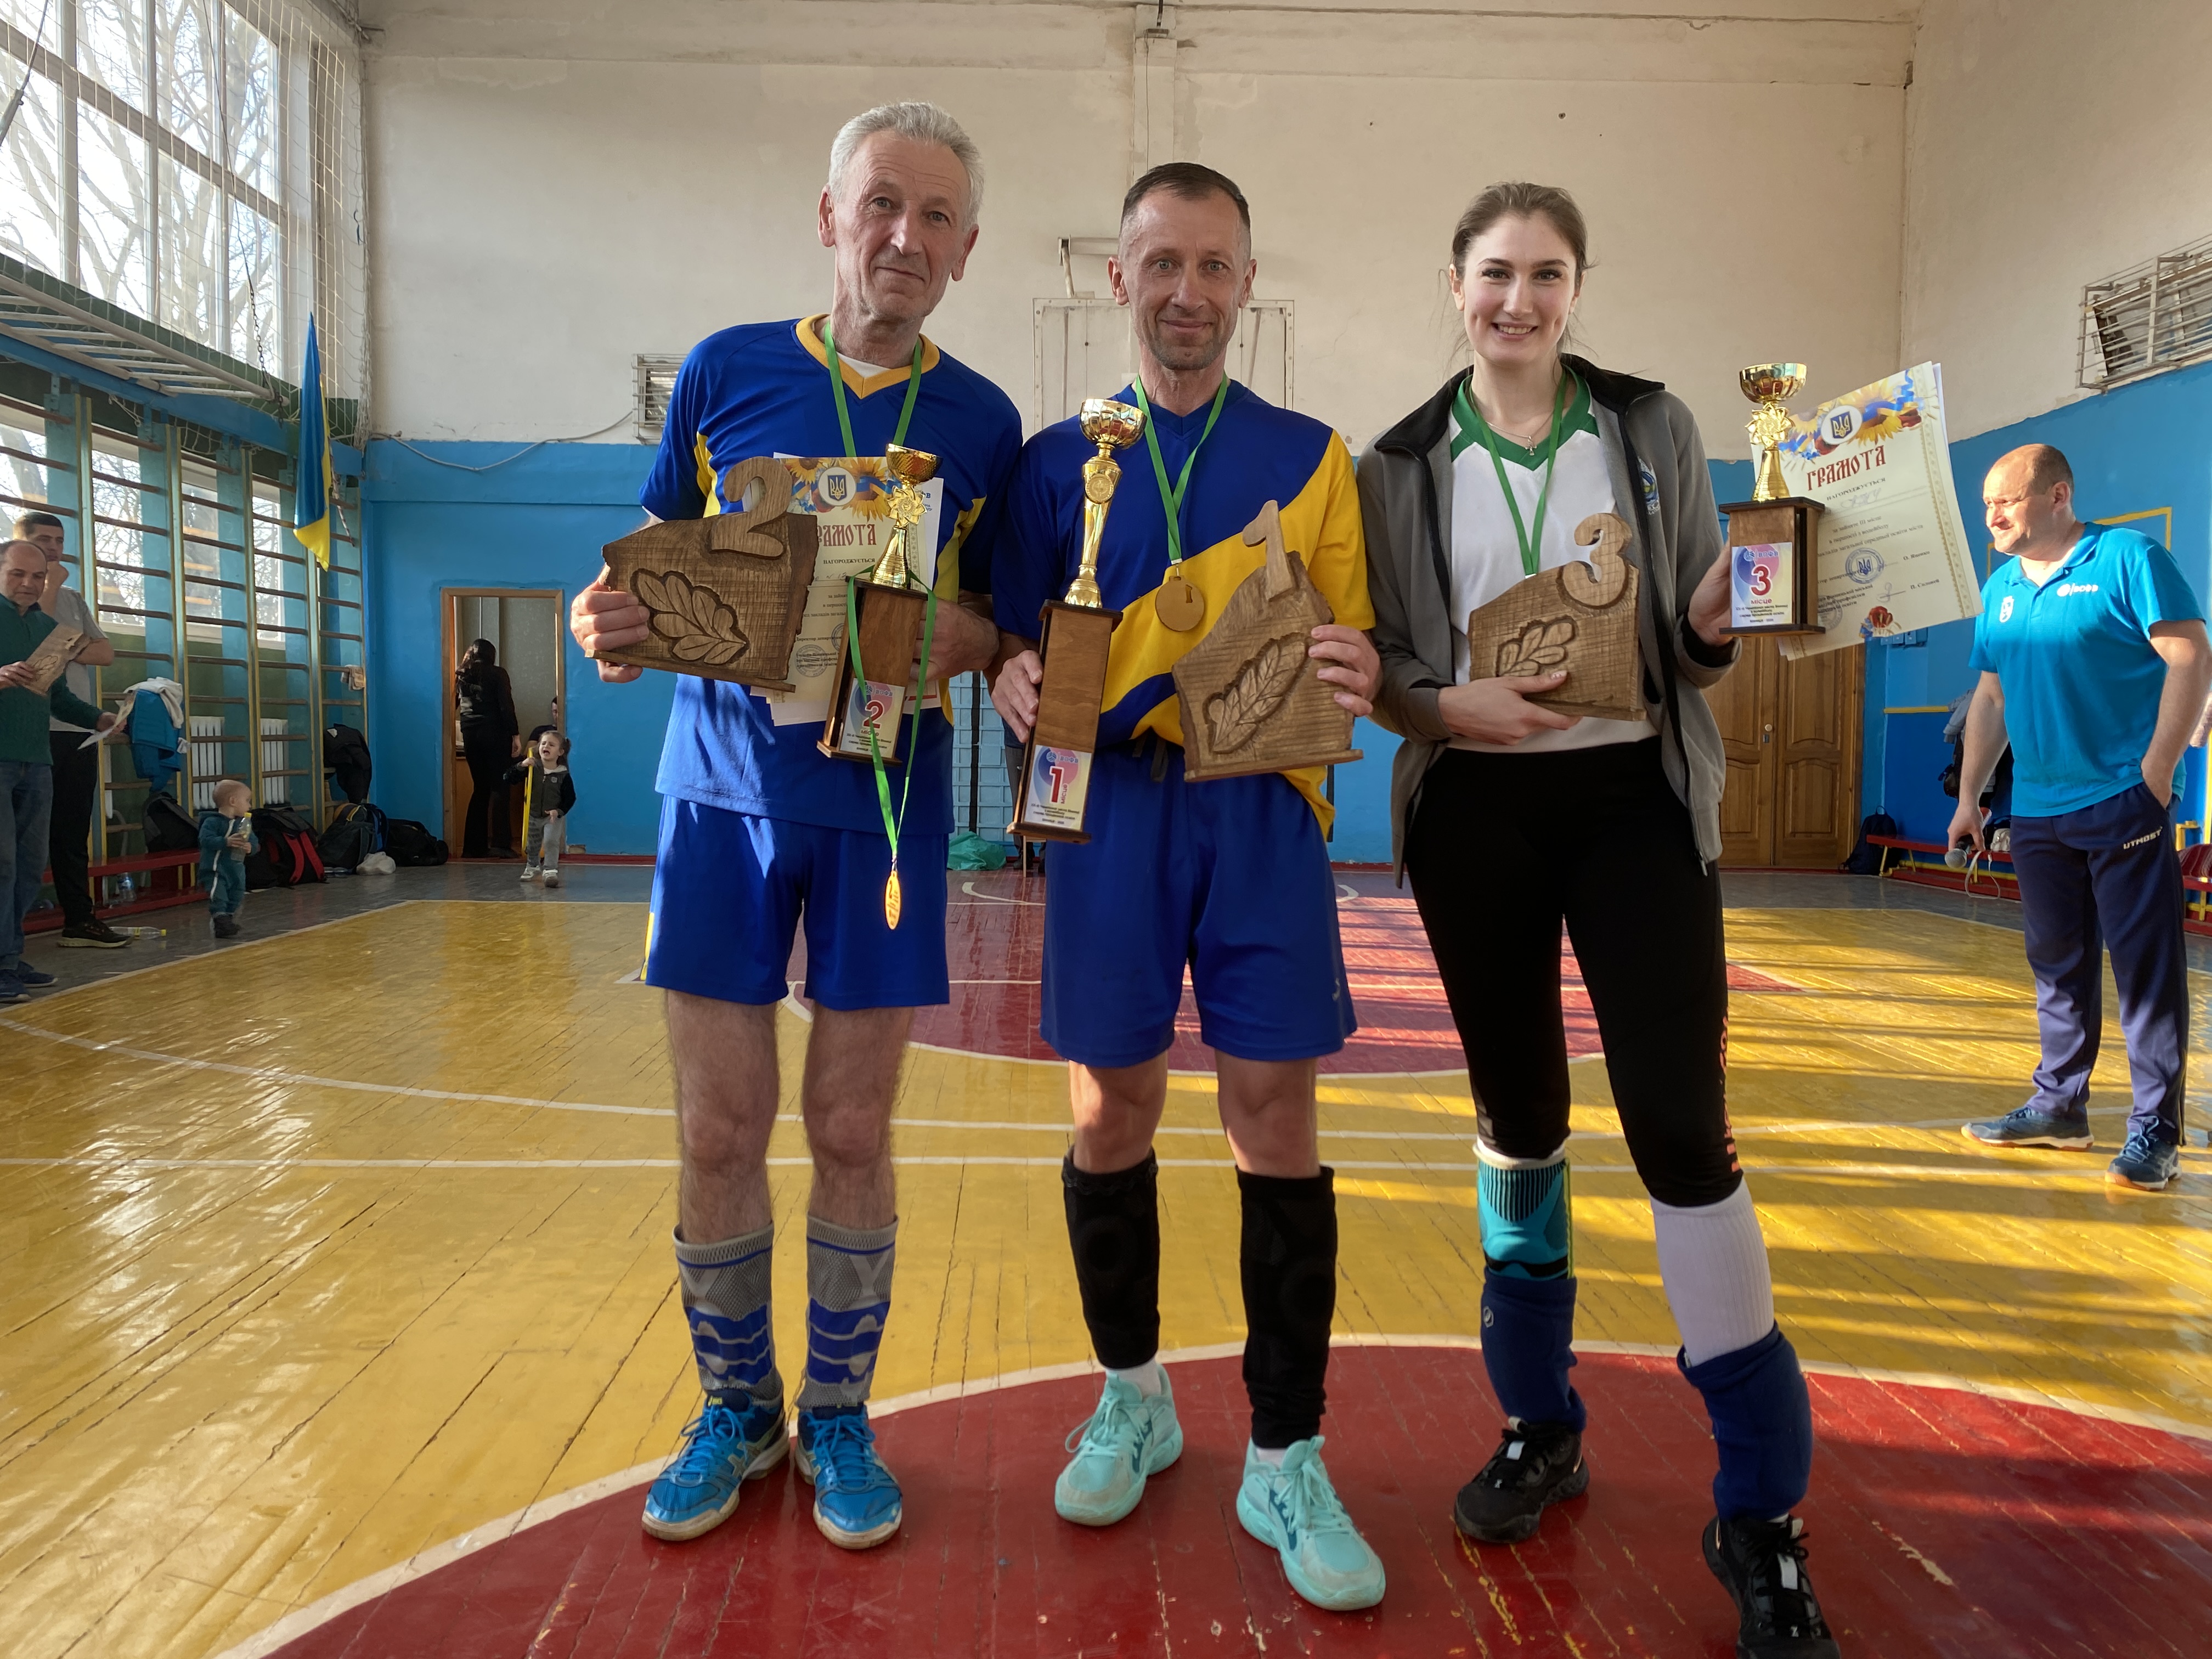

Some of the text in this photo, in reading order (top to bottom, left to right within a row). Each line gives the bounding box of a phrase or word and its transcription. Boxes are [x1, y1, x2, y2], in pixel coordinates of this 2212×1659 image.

[1807, 445, 1886, 491] ГРАМОТА
[712, 456, 793, 559] 2
[817, 524, 877, 546] АМОТА
[1242, 500, 1296, 602] 1
[1563, 512, 1632, 608] 3
[1751, 566, 1771, 596] 3
[864, 701, 884, 729] 2
[1060, 755, 1079, 764] ВОФВ
[1051, 768, 1063, 803] 1
[2123, 829, 2162, 850] UTMOST
